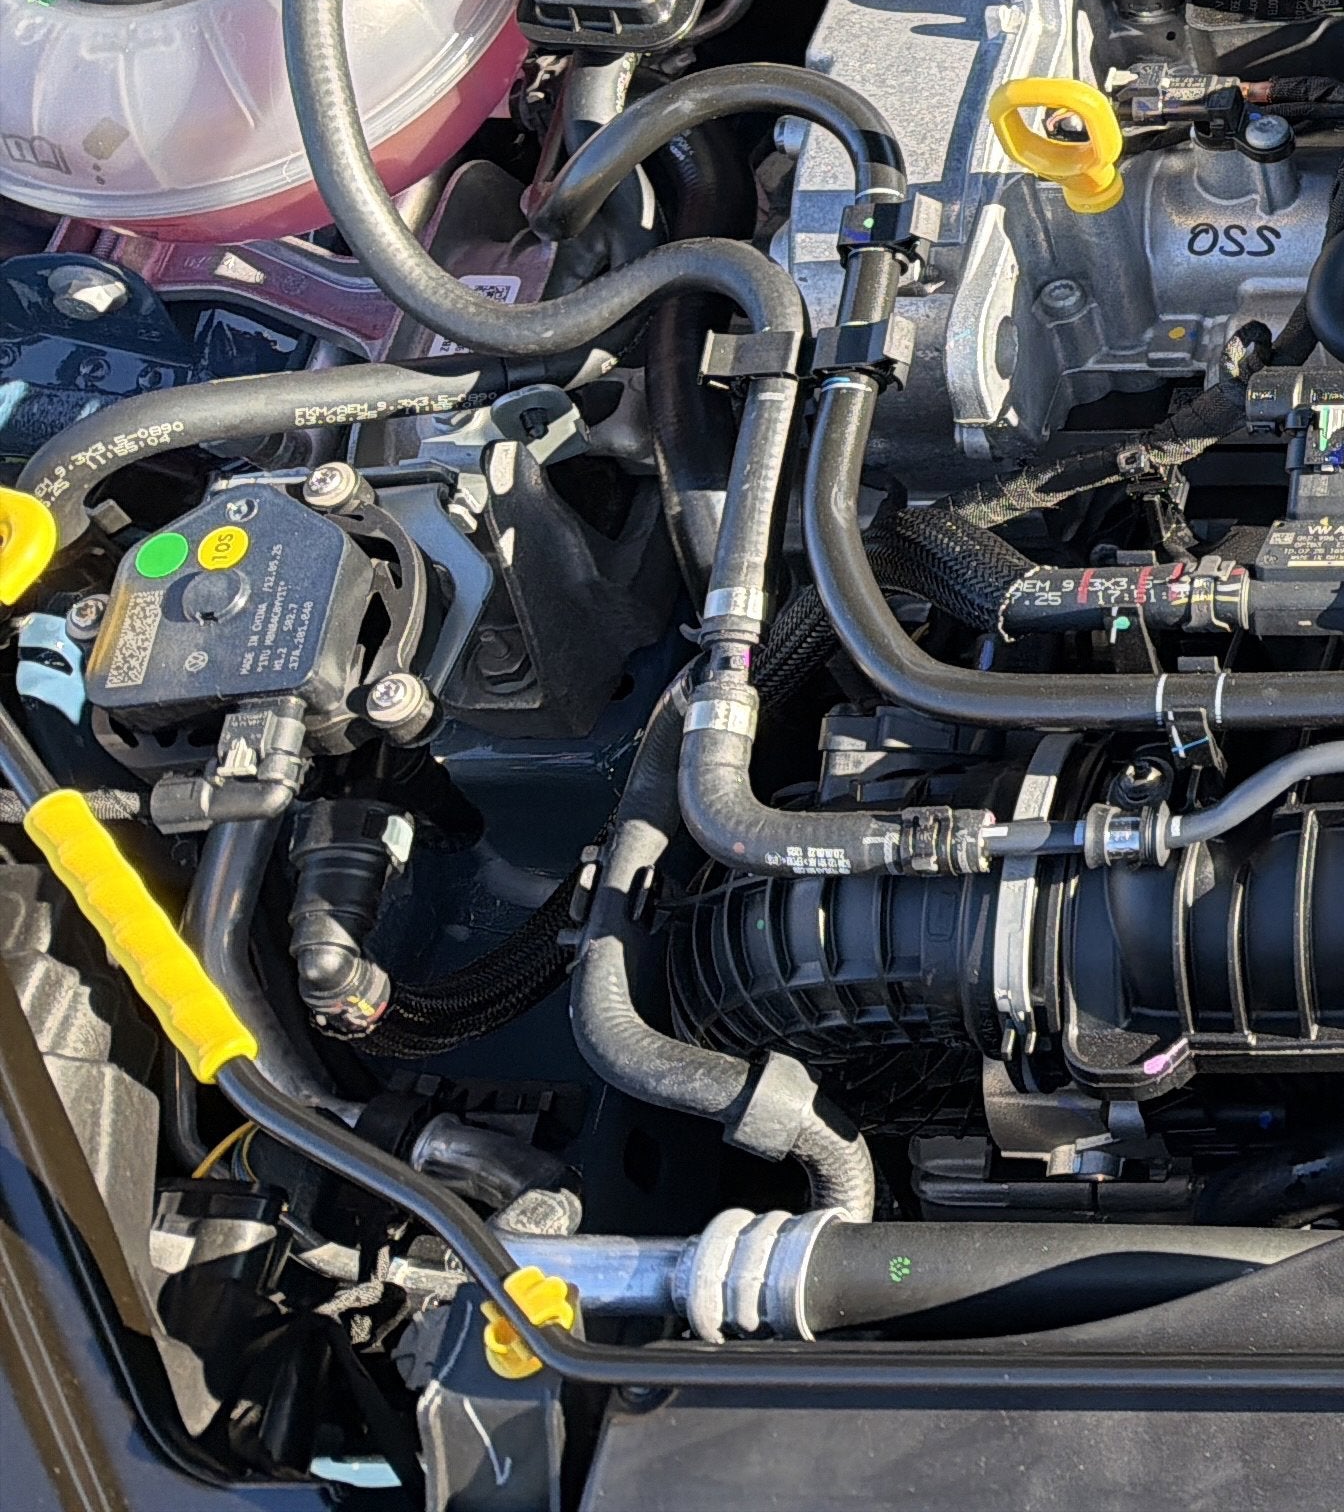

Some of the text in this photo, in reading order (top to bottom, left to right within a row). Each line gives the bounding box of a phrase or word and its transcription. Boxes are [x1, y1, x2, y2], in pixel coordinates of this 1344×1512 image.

[1187, 222, 1281, 257] OSS
[1308, 525, 1333, 535] VW
[250, 599, 268, 632] CHINA
